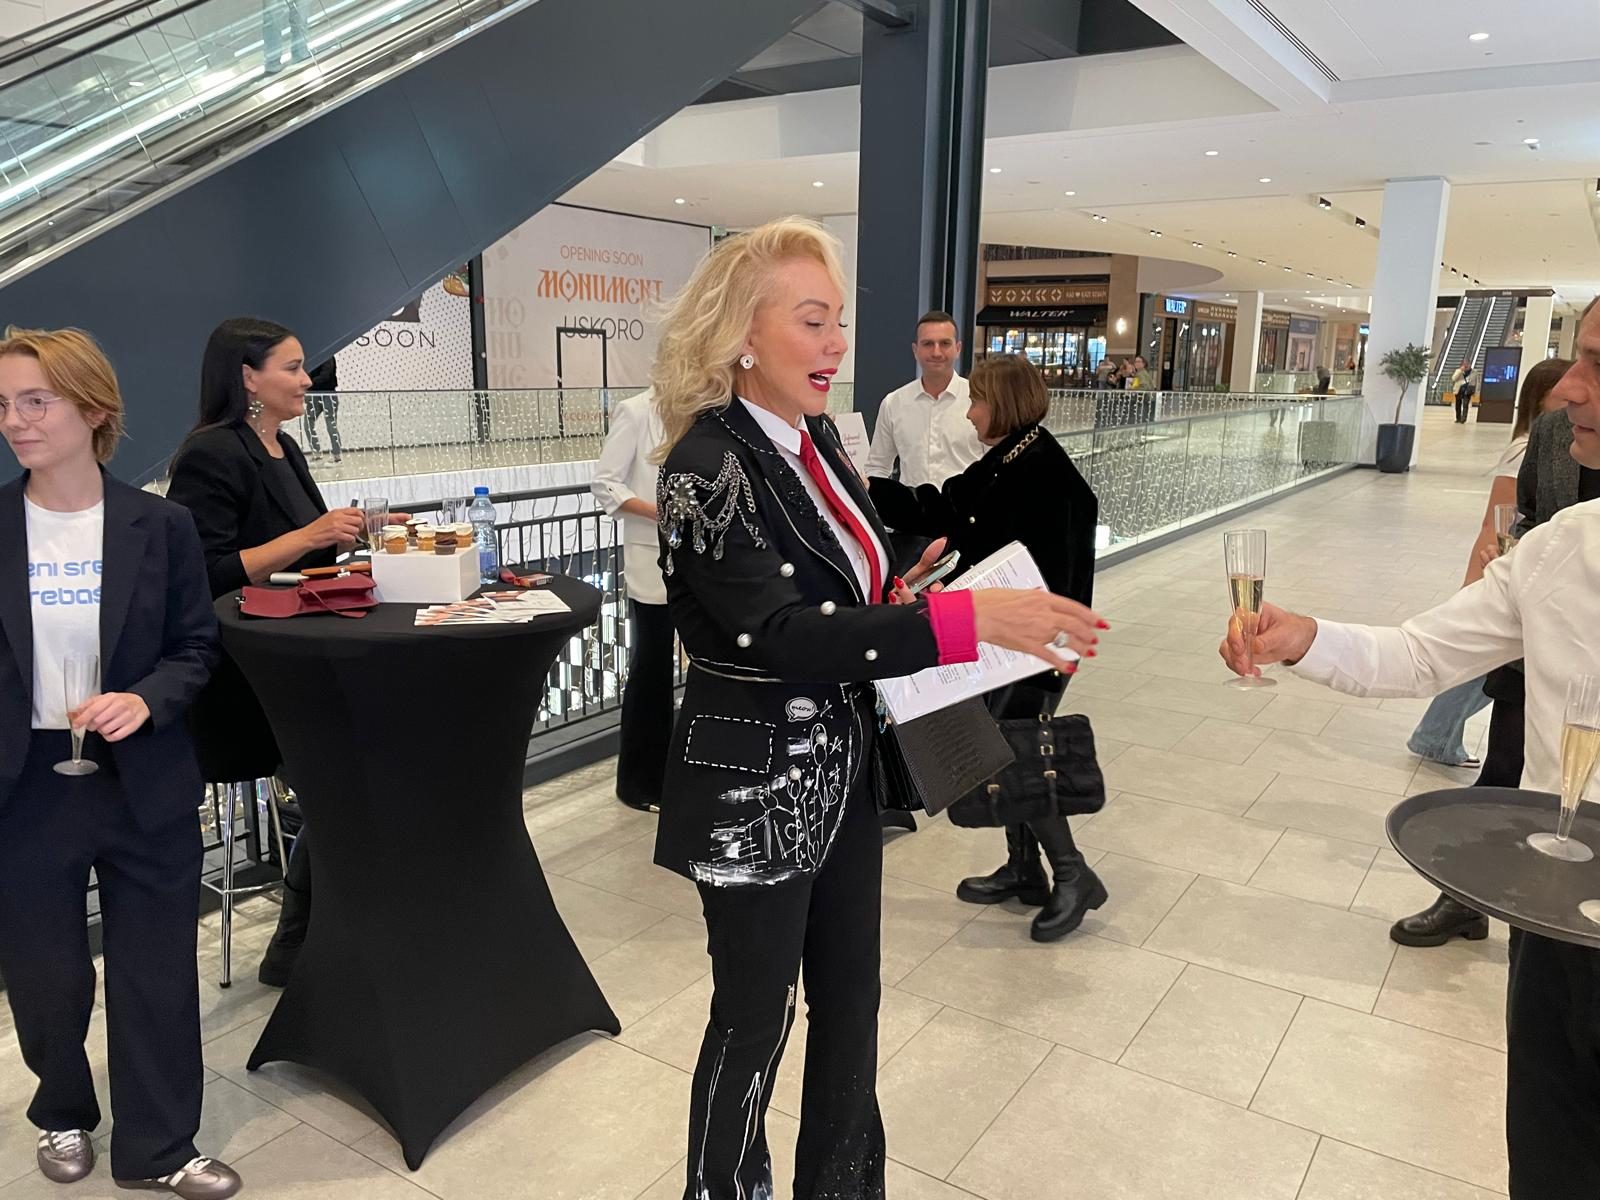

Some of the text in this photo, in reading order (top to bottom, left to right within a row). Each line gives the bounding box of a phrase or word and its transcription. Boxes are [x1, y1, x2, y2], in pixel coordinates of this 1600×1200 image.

[560, 244, 644, 267] OPENING SOON
[537, 269, 664, 304] MONUMENT
[563, 315, 644, 341] USKORO
